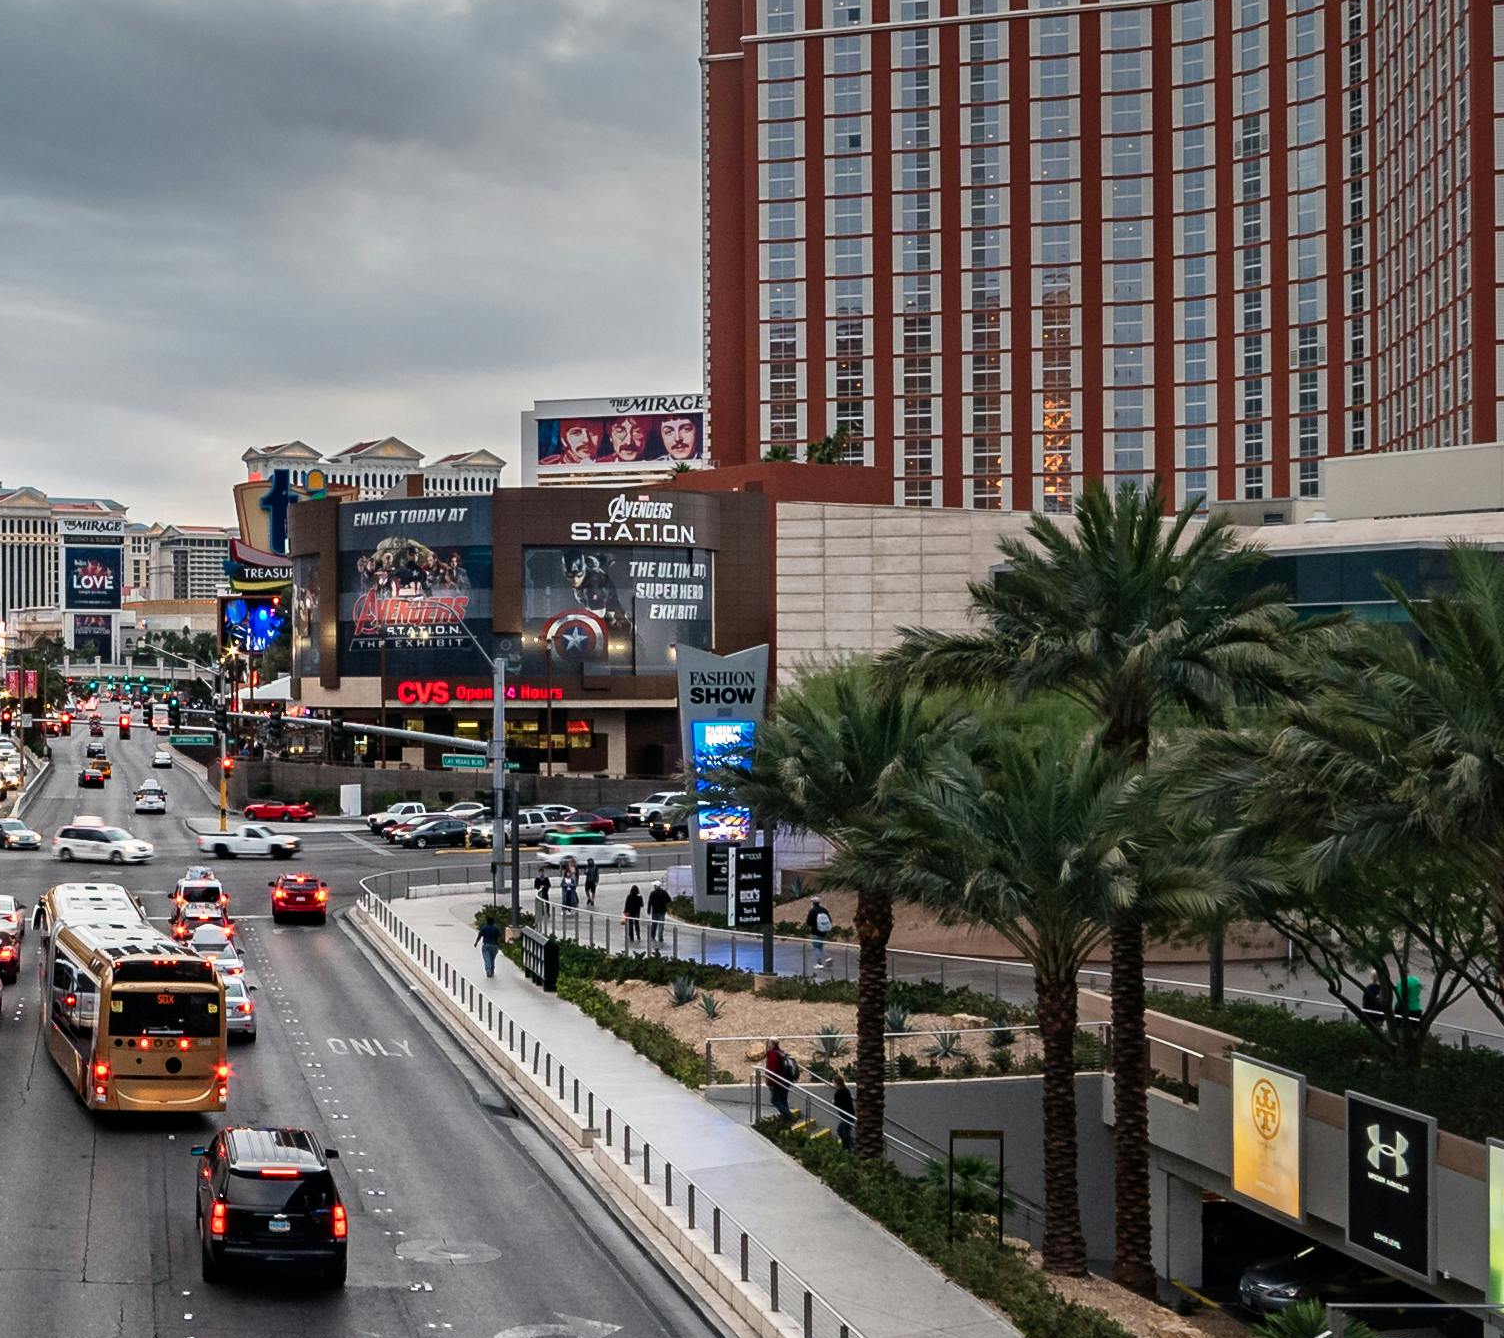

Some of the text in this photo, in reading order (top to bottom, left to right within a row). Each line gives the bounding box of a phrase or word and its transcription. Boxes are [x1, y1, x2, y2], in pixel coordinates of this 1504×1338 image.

[610, 396, 703, 412] THE MIRAGE
[608, 493, 673, 523] AVENGERS
[353, 508, 468, 527] ENLIST TODAY AT
[71, 521, 122, 532] MIRAGE
[629, 562, 656, 578] THE
[73, 575, 114, 590] LOVE
[635, 583, 679, 600] SUPER
[353, 587, 469, 636] AVENGERS
[395, 639, 464, 648] EXHIBIT
[690, 671, 755, 686] FASHION
[397, 681, 451, 704] CVS
[456, 685, 494, 702] Open
[520, 685, 563, 700] Hours
[690, 688, 756, 704] SHOW
[326, 1038, 414, 1057] ONLY
